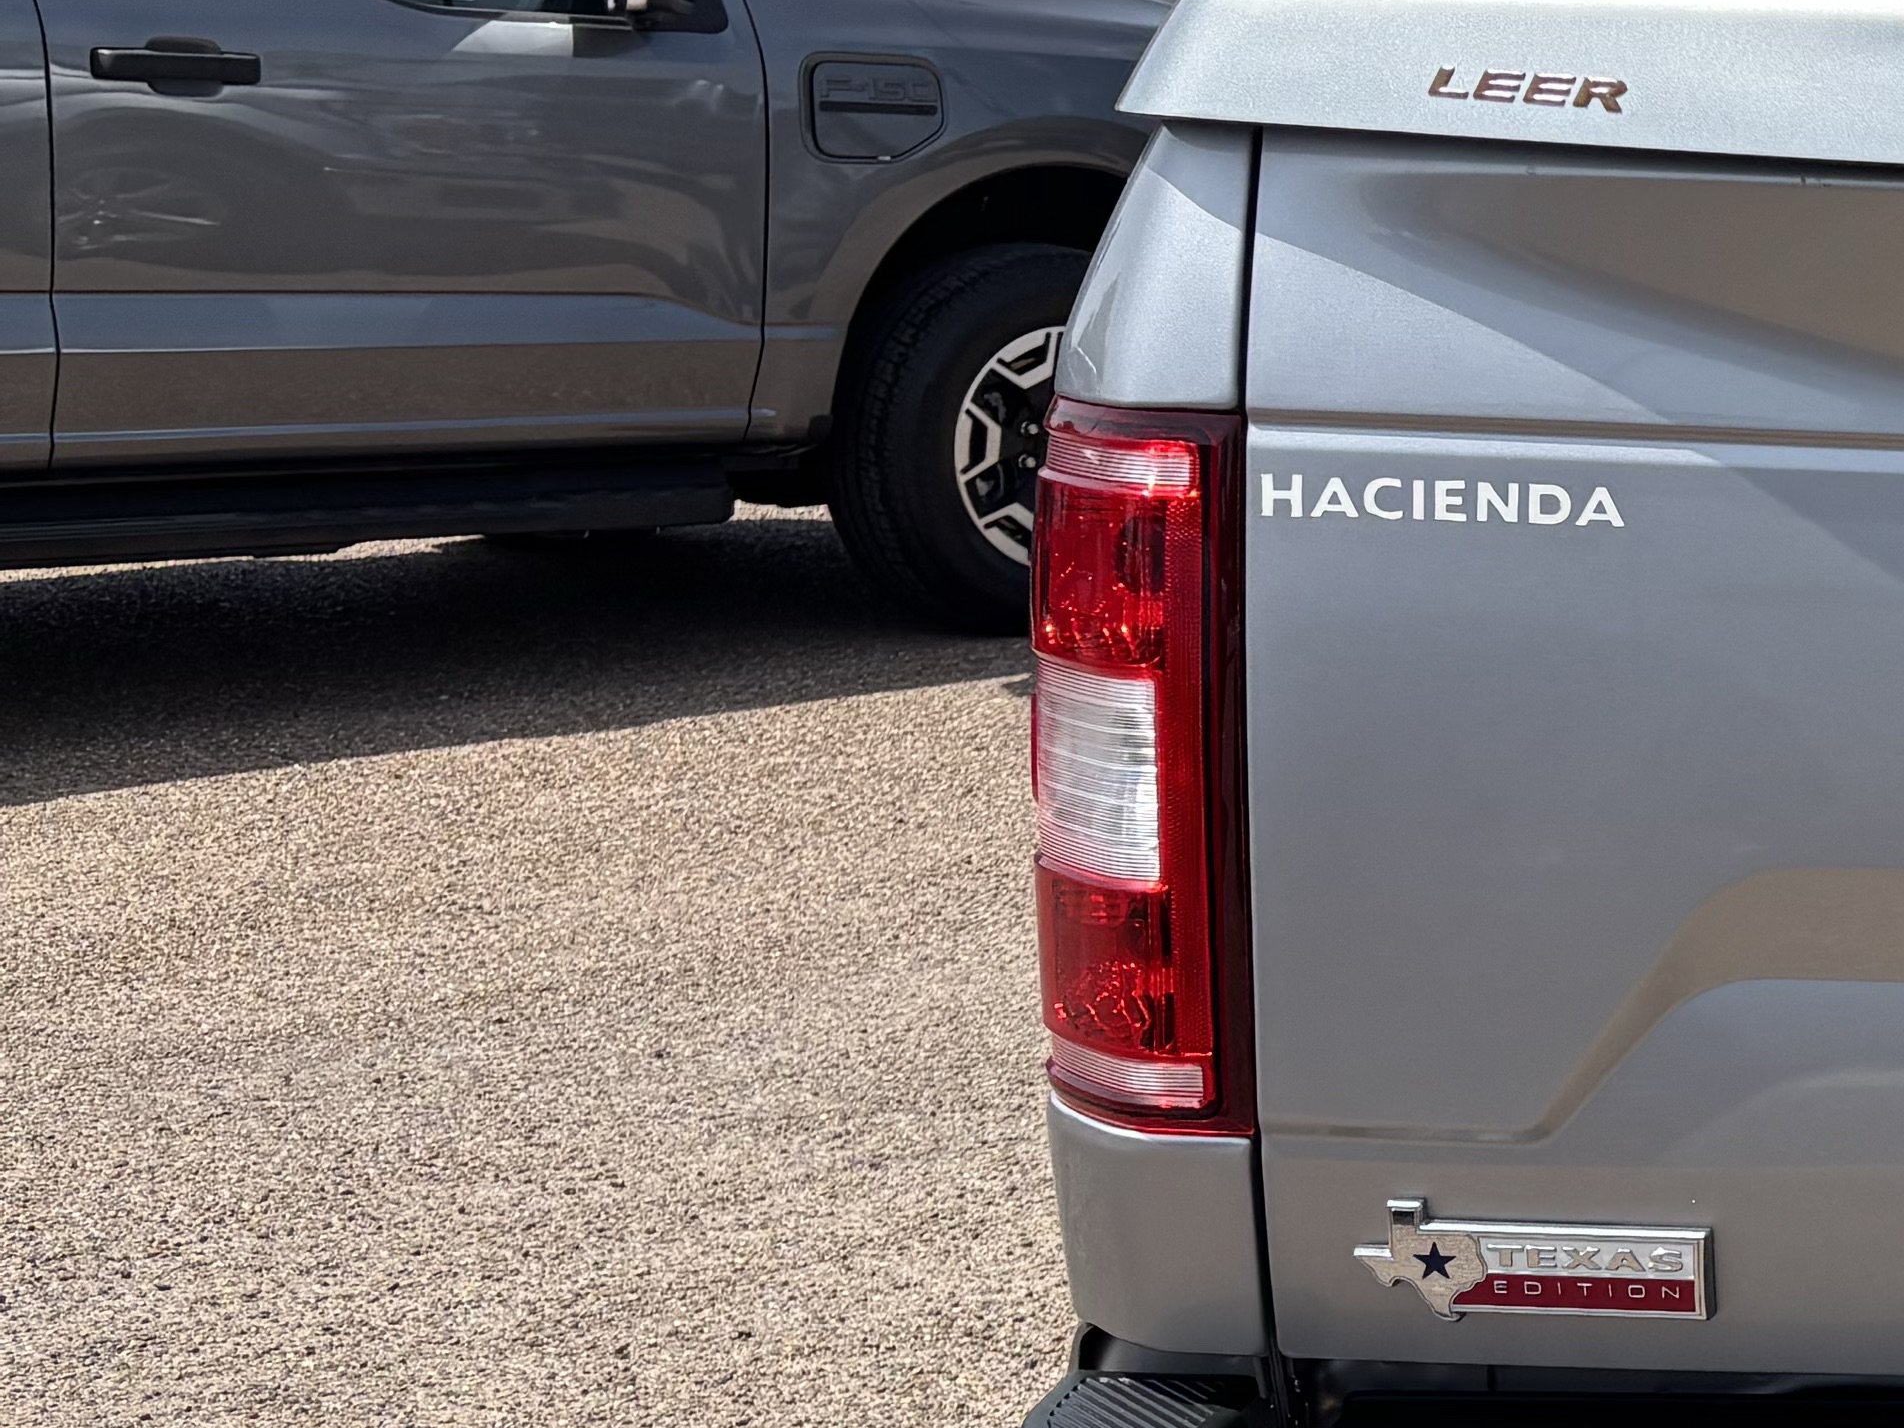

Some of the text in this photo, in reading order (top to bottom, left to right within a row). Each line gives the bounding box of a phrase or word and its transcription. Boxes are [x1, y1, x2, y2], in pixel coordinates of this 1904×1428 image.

[1427, 65, 1629, 114] LEER
[1259, 472, 1626, 529] HACIENDA
[1486, 1243, 1684, 1273] TEXAS
[1493, 1280, 1681, 1300] EDITION
